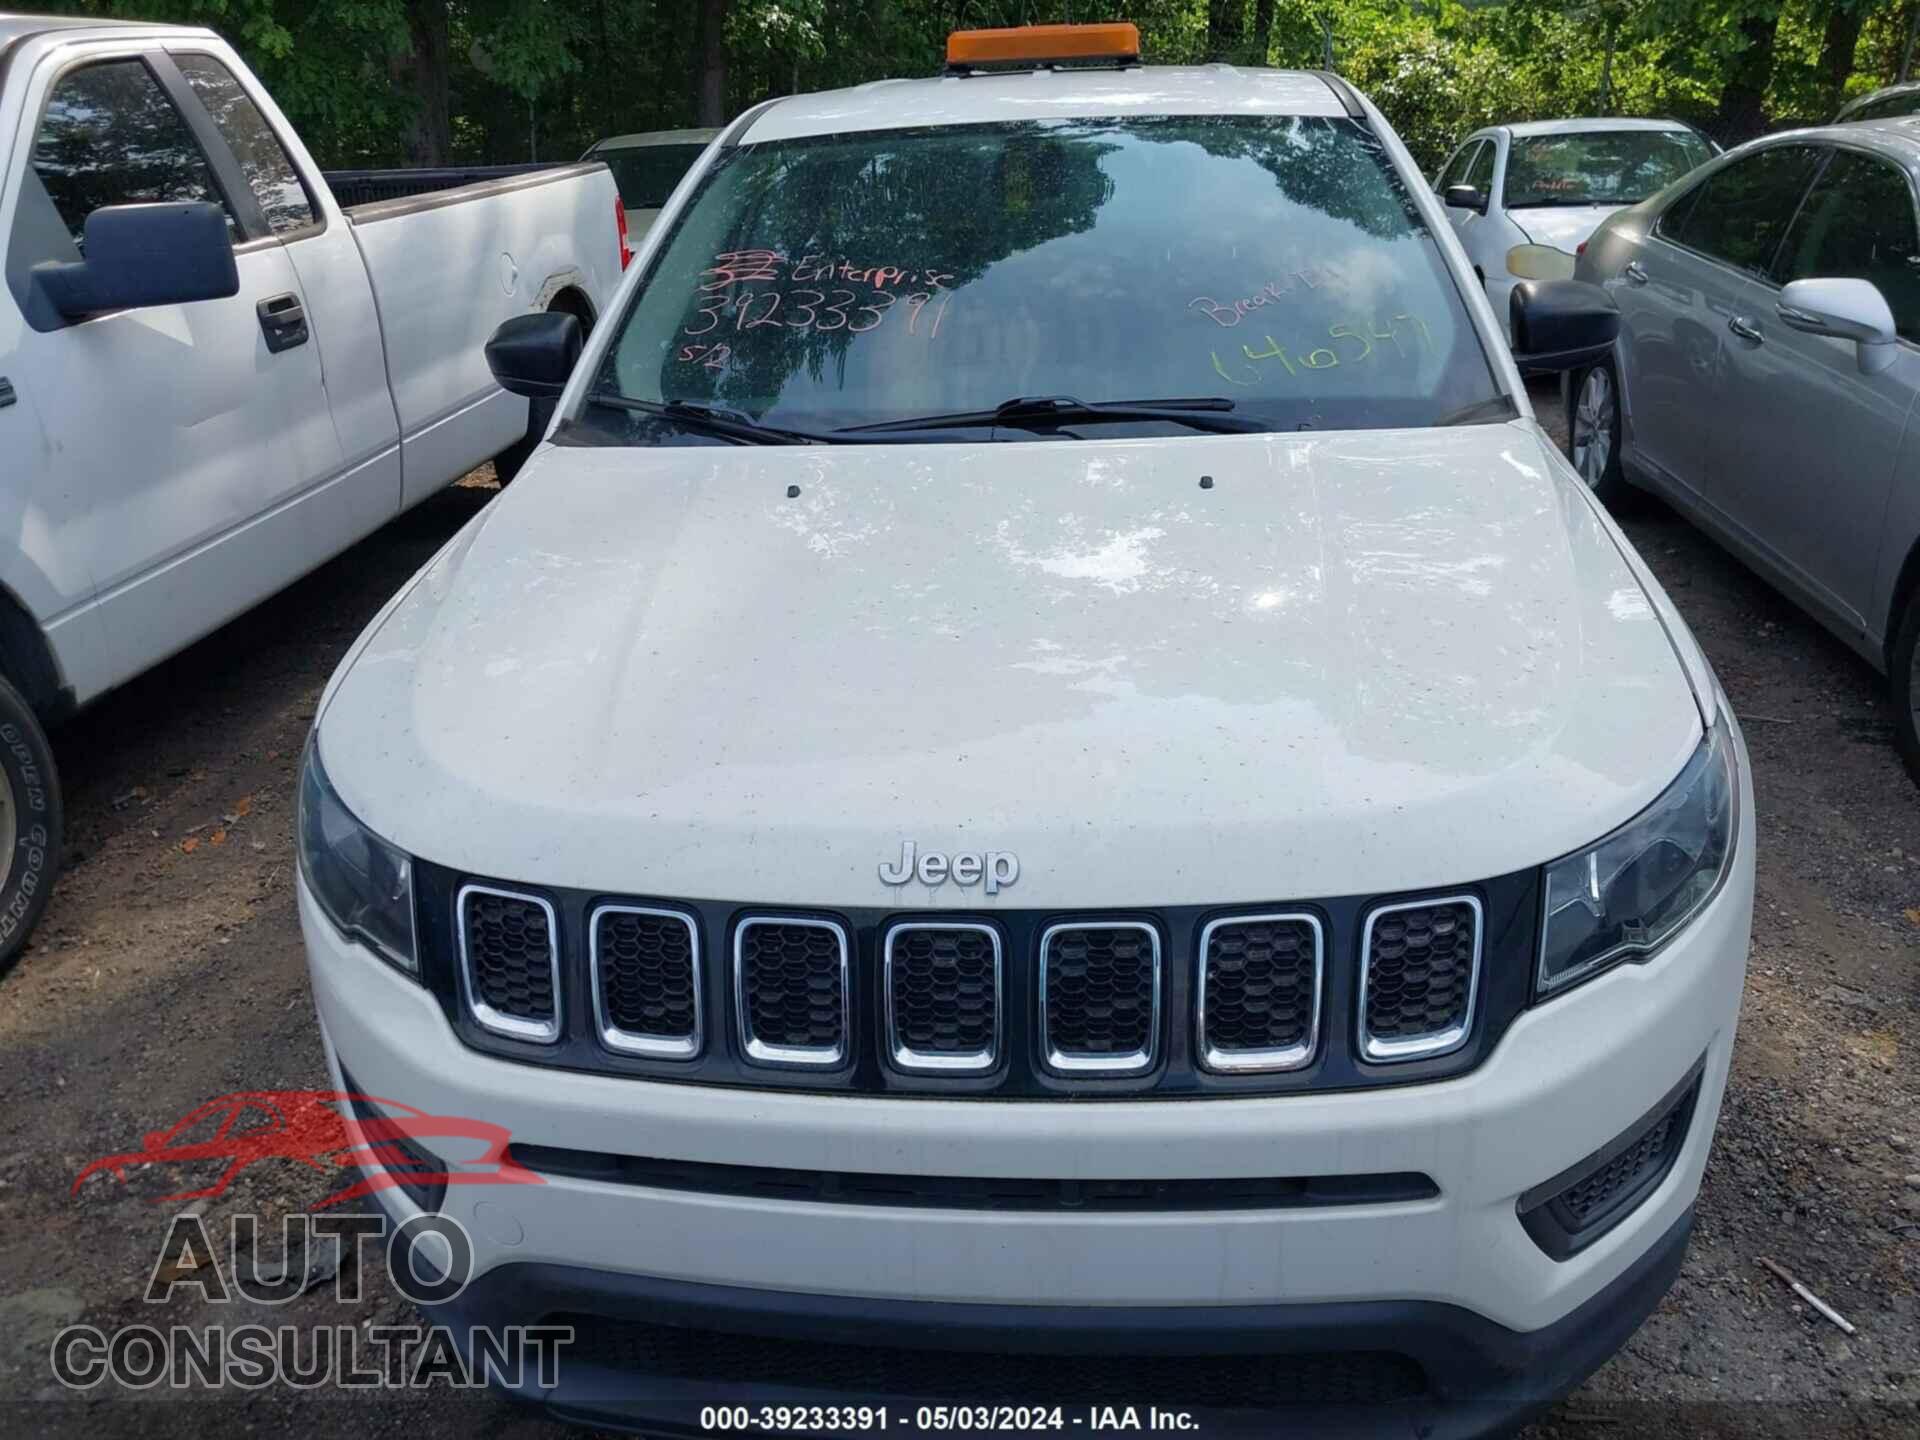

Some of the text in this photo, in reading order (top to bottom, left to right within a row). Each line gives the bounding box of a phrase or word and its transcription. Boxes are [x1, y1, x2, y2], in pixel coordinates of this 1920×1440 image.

[791, 254, 954, 289] Enterprise
[685, 289, 952, 339] 39233391
[1187, 282, 1289, 328] Break
[1, 722, 46, 812] OPEN
[879, 840, 1020, 895] Jeep
